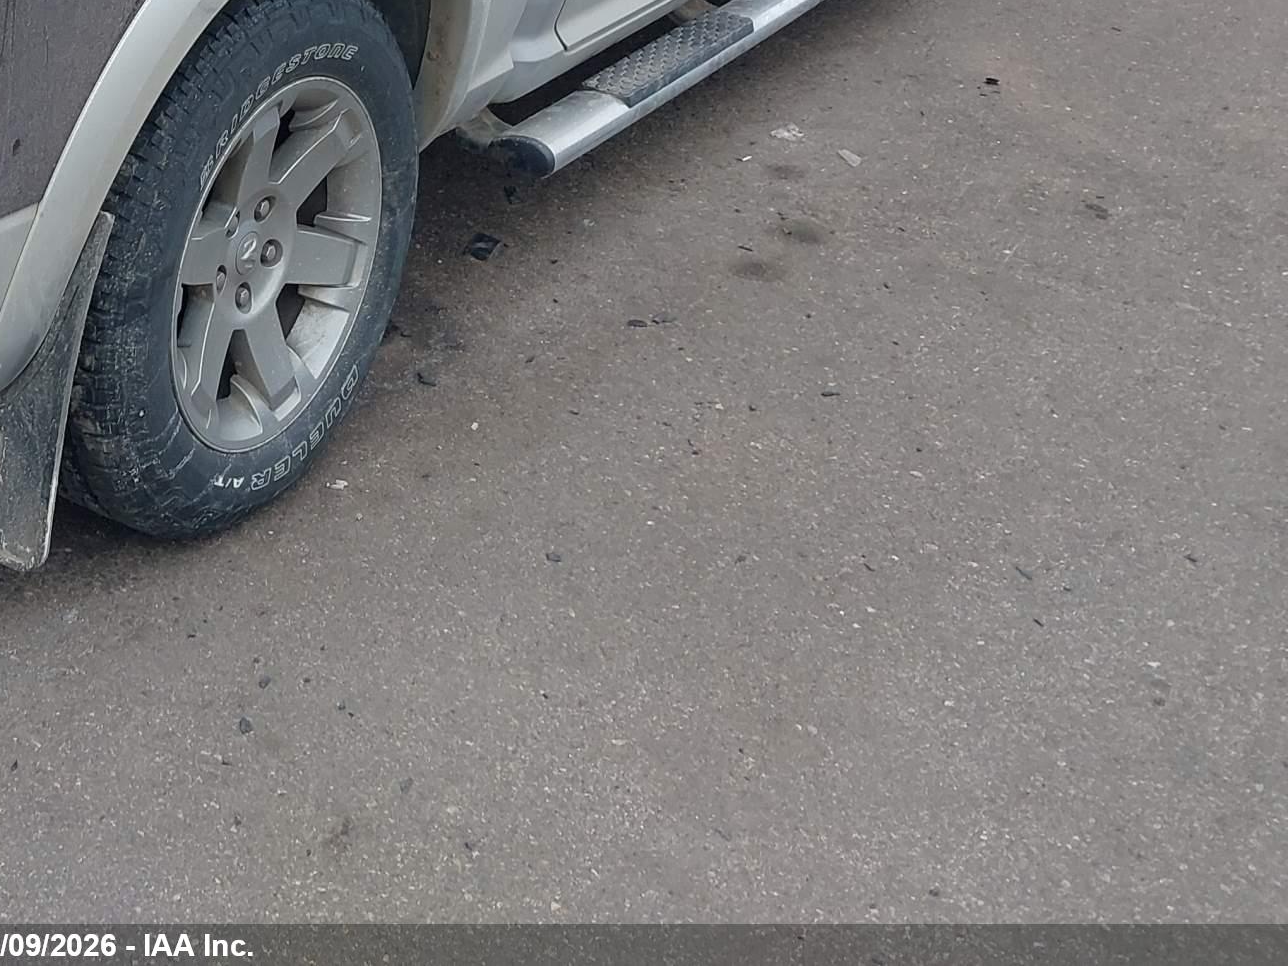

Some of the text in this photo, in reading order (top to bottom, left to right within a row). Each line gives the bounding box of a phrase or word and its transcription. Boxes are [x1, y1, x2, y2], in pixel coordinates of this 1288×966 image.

[199, 42, 359, 192] BRIDGESTONE
[212, 365, 359, 491] DUELER A/T
